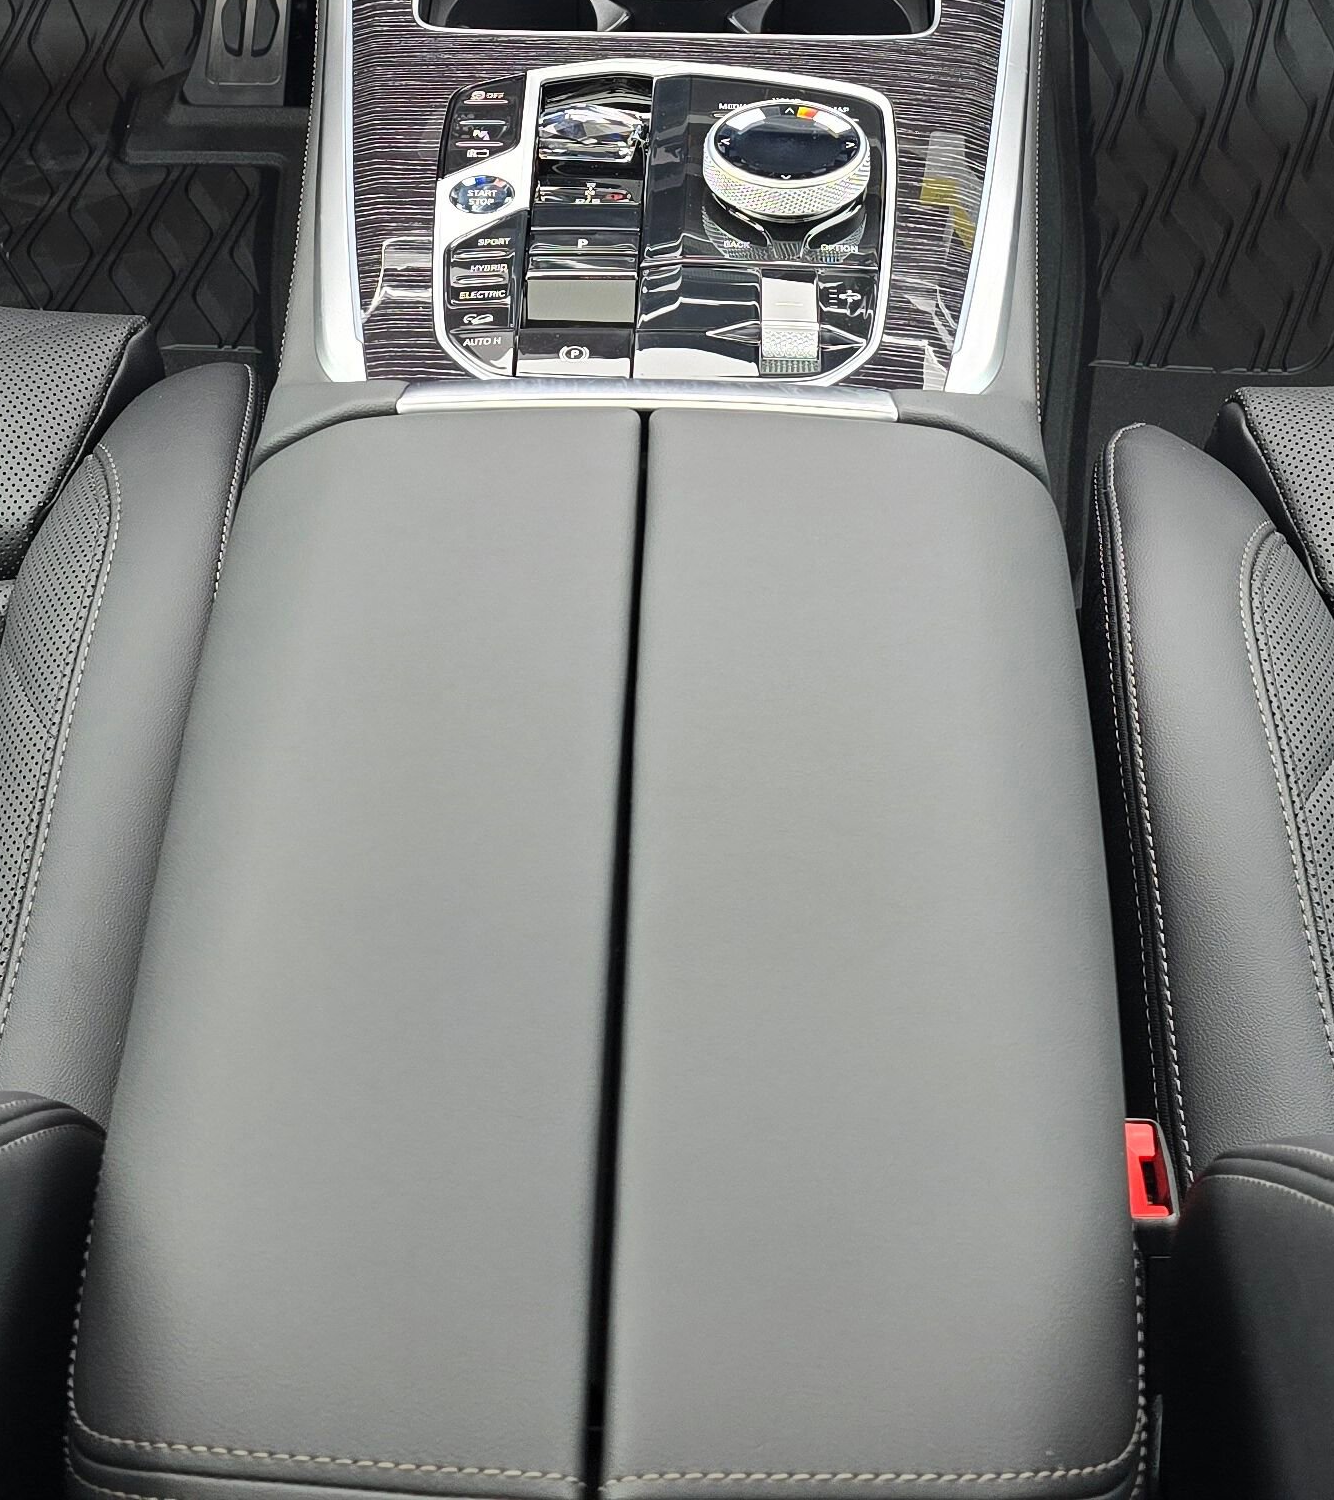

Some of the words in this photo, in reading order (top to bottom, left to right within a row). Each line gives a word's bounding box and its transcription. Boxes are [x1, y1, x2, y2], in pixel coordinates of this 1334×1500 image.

[468, 198, 495, 206] STOP
[477, 237, 511, 246] SPORT
[577, 239, 589, 249] P
[724, 240, 751, 249] BACK
[820, 243, 859, 253] OPTION
[470, 263, 508, 273] HYBRID
[459, 290, 506, 300] ELECTRIC
[462, 338, 491, 347] AUTO
[493, 337, 502, 345] H
[570, 349, 580, 359] P
